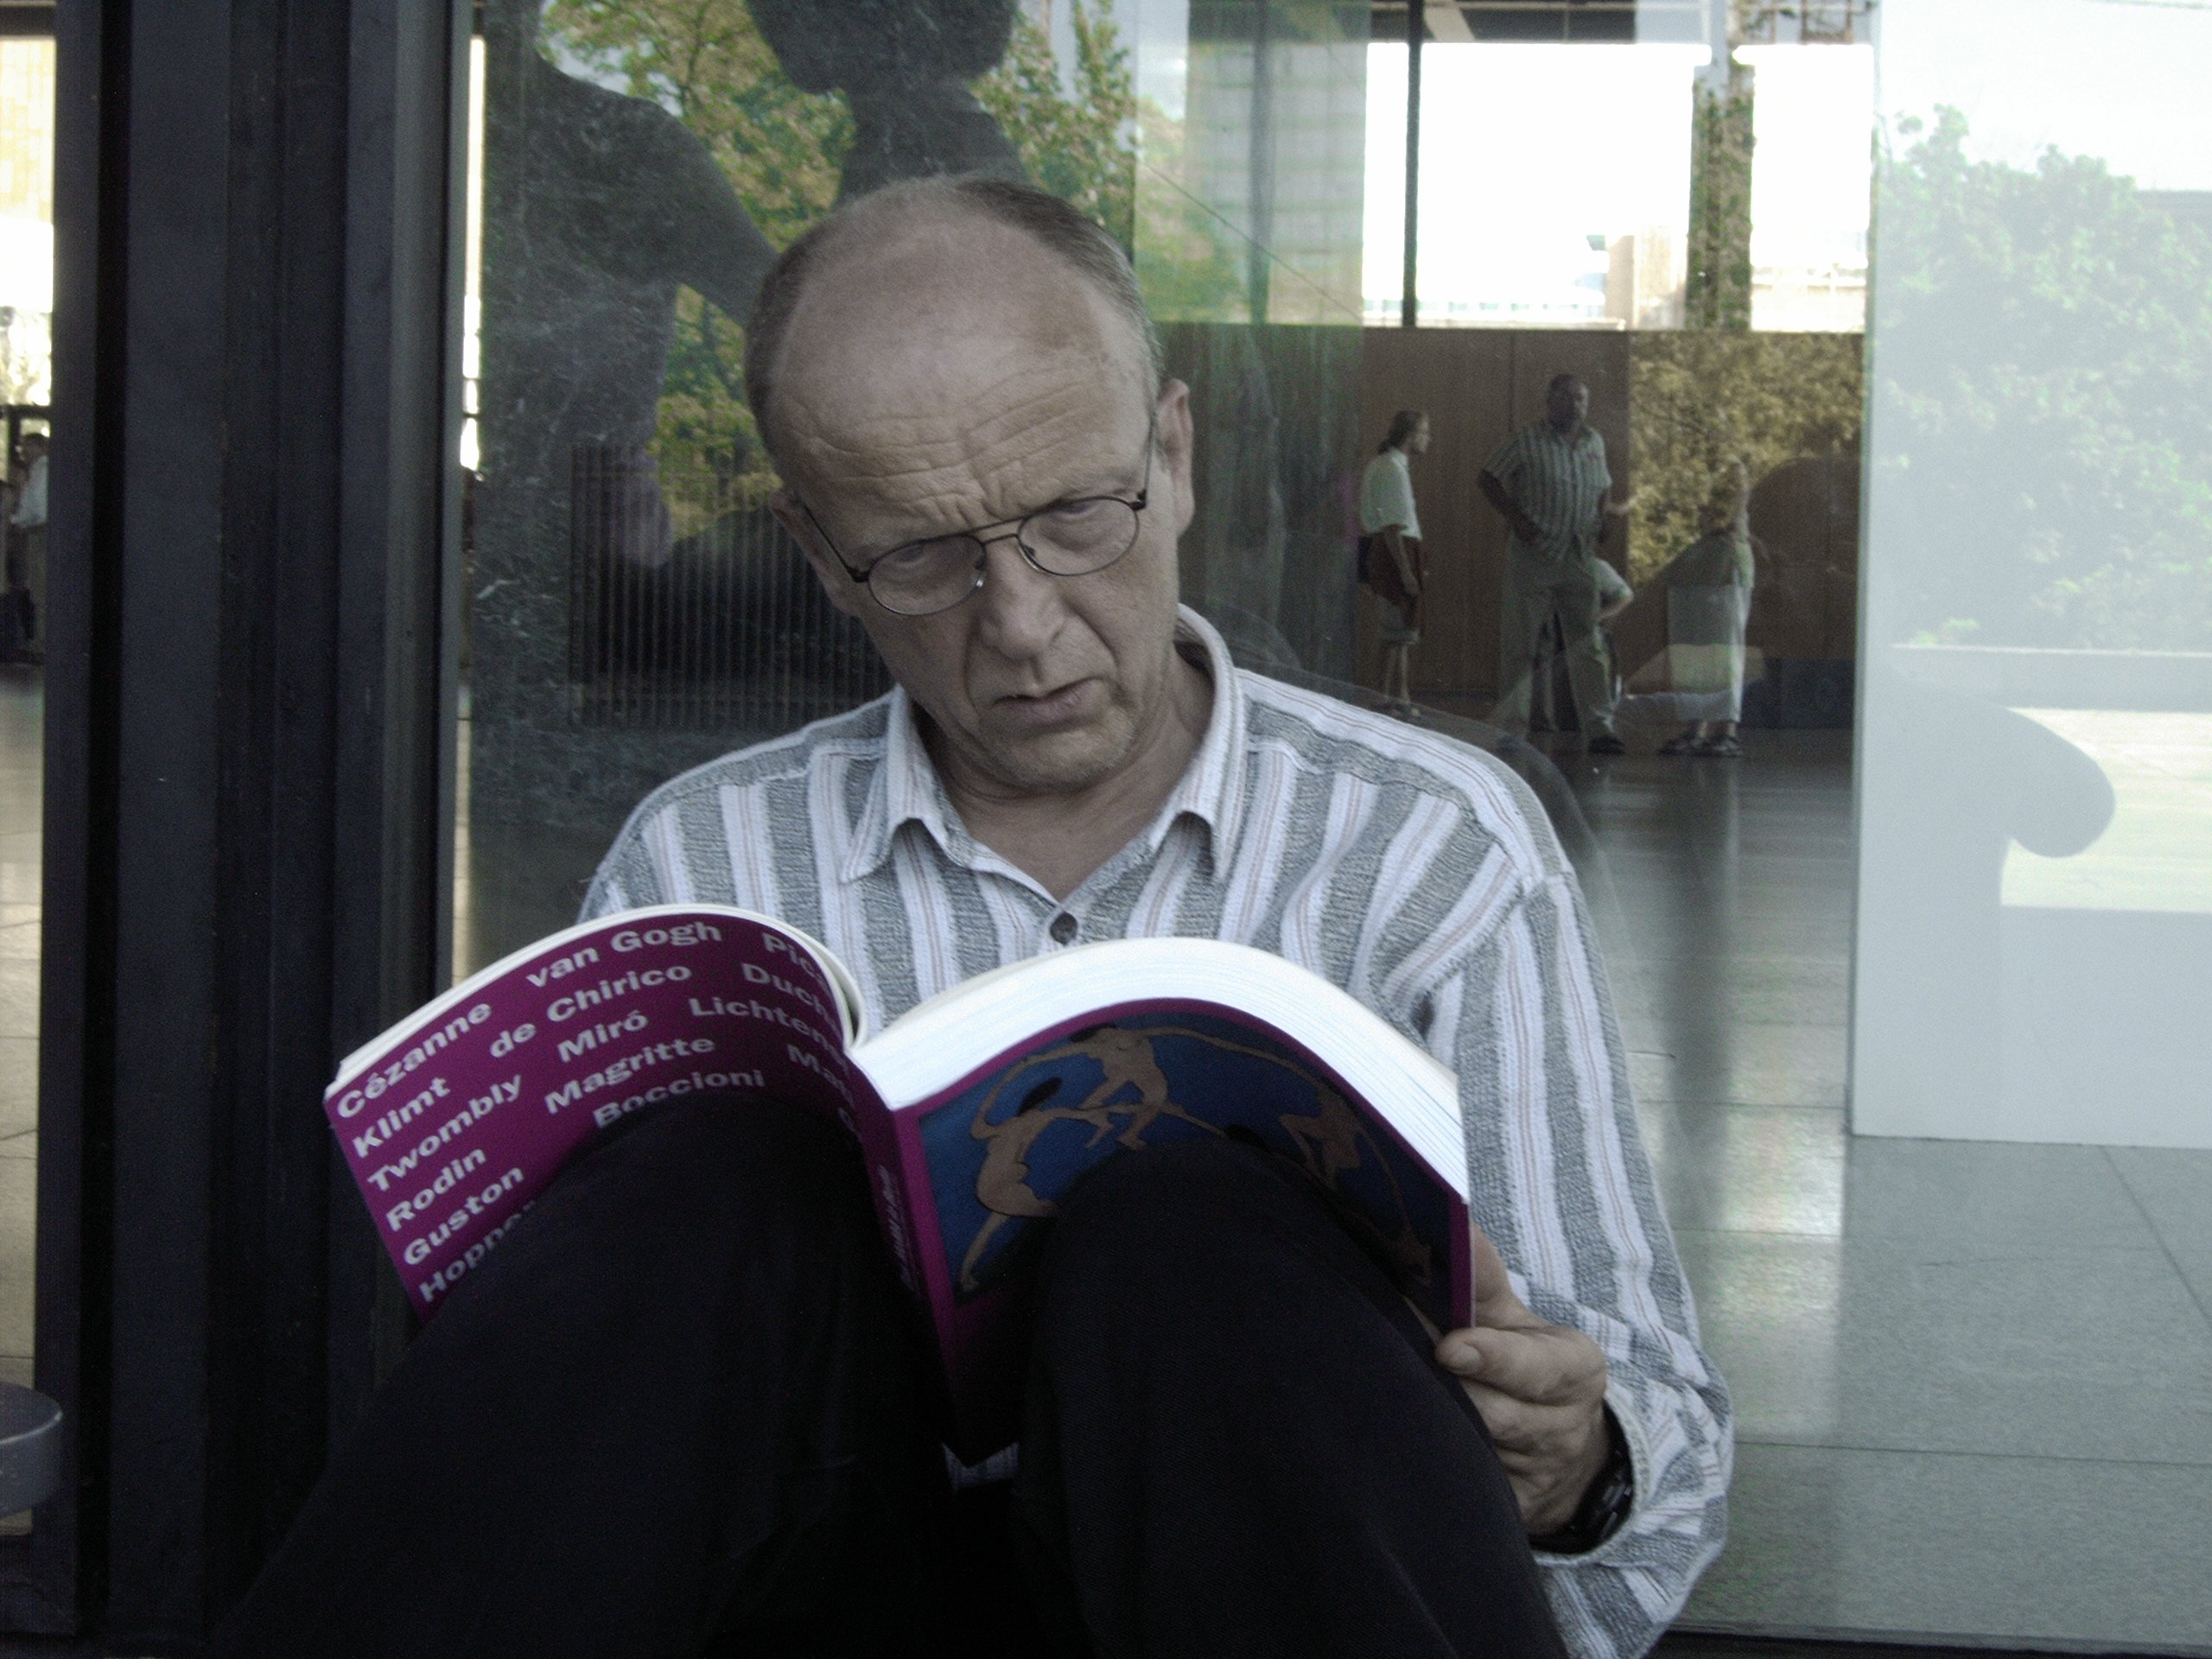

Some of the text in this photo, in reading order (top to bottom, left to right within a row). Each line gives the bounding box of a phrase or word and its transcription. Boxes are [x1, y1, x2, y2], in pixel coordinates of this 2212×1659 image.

[337, 921, 830, 1118] Cézanne van Gogh Pic
[353, 963, 842, 1158] Klimt de Chirico Duch
[368, 1074, 522, 1191] Twombly
[558, 1010, 648, 1063] Miró
[386, 1147, 486, 1231] Rodin
[545, 1038, 715, 1114] Magritte
[405, 1166, 524, 1266] Guston
[594, 1070, 764, 1128] Boccioni
